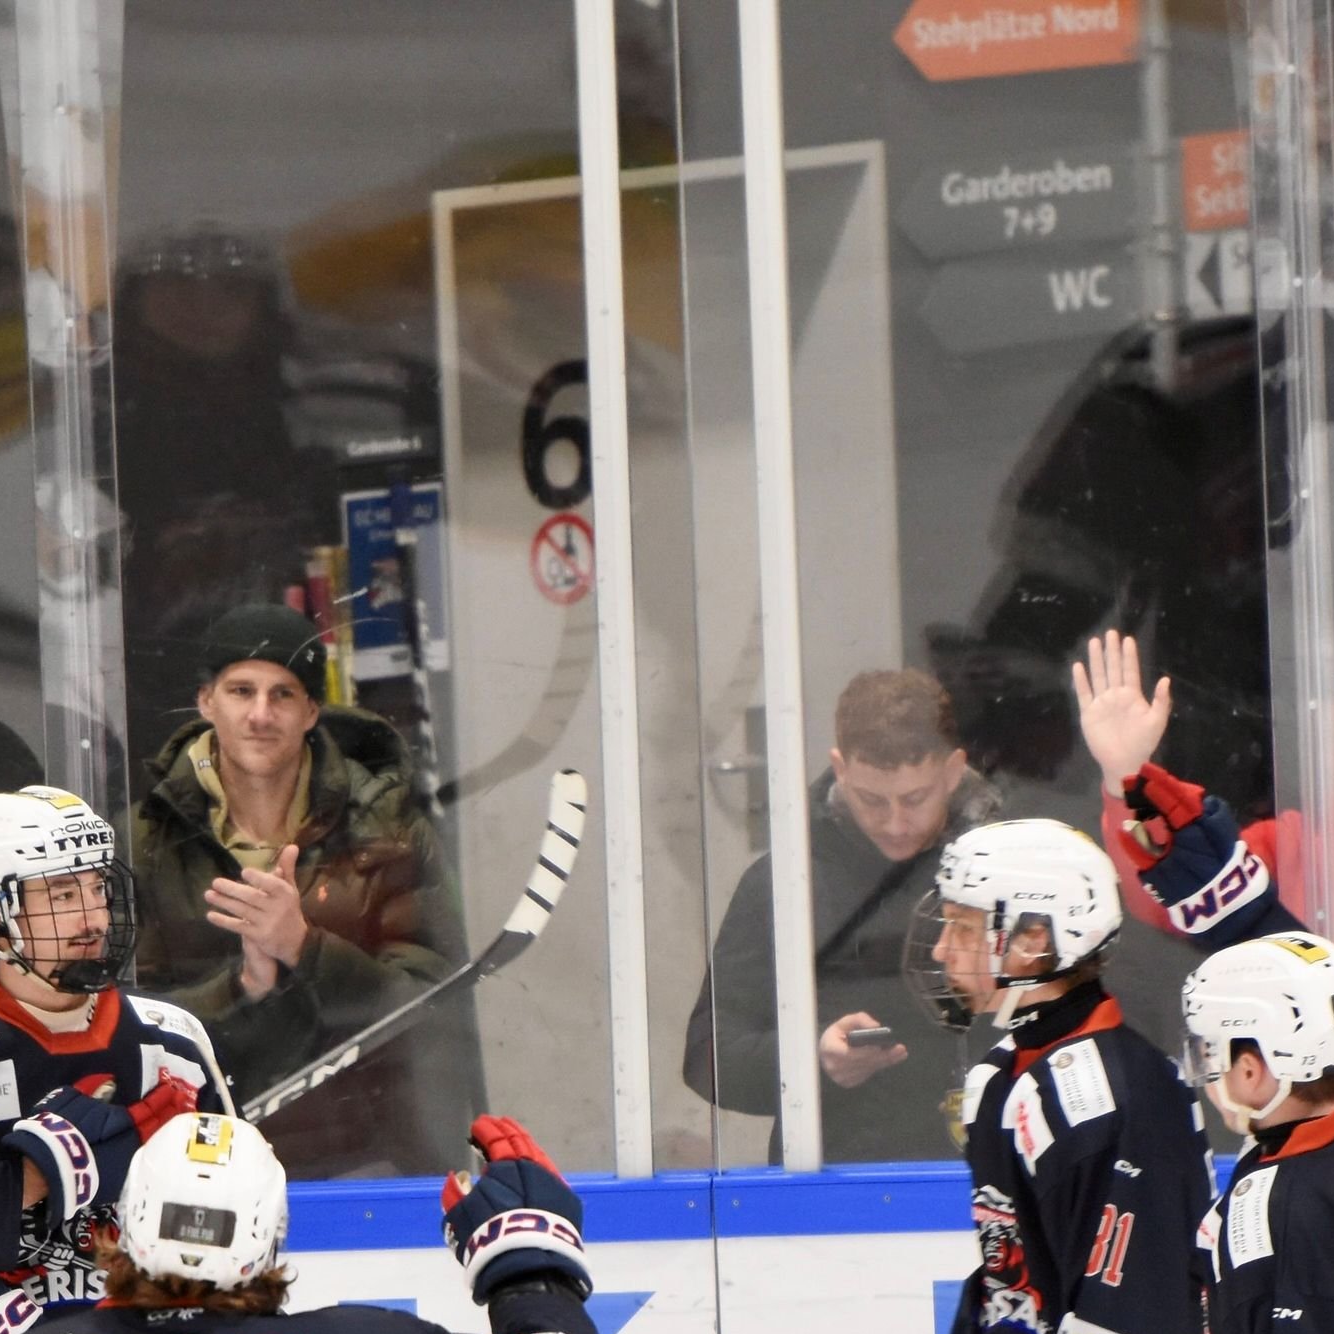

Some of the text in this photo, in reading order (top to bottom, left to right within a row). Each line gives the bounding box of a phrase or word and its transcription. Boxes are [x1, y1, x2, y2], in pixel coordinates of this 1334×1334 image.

[913, 2, 1119, 53] Stehplätze Nord
[941, 157, 1112, 206] Garderoben
[1003, 203, 1058, 238] 7+9
[1048, 263, 1112, 312] WC
[523, 360, 593, 509] 6
[1014, 892, 1057, 901] CCM
[466, 1212, 585, 1264] CCM
